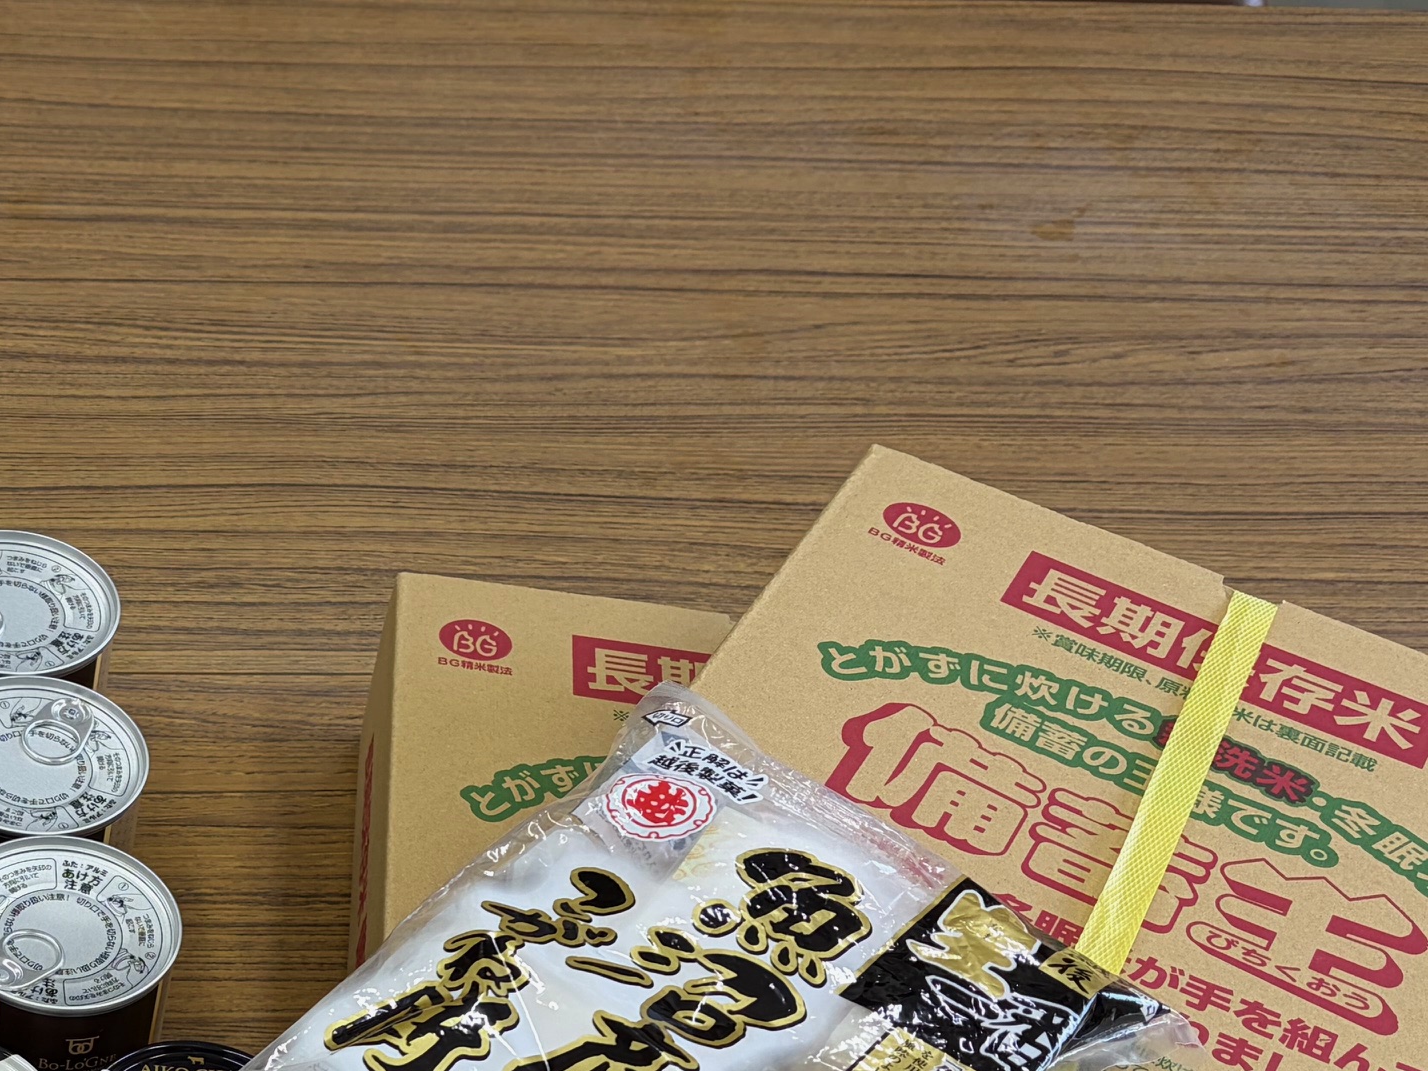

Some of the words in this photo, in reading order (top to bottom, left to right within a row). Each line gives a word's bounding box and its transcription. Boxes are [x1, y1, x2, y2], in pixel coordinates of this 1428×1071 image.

[867, 526, 946, 565] BG精米製法
[438, 656, 513, 676] BG精米製法
[1023, 569, 1420, 750] 長期存米
[62, 869, 103, 887] あけ方
[64, 880, 94, 895] 注意
[1206, 929, 1372, 1012] びちくおう
